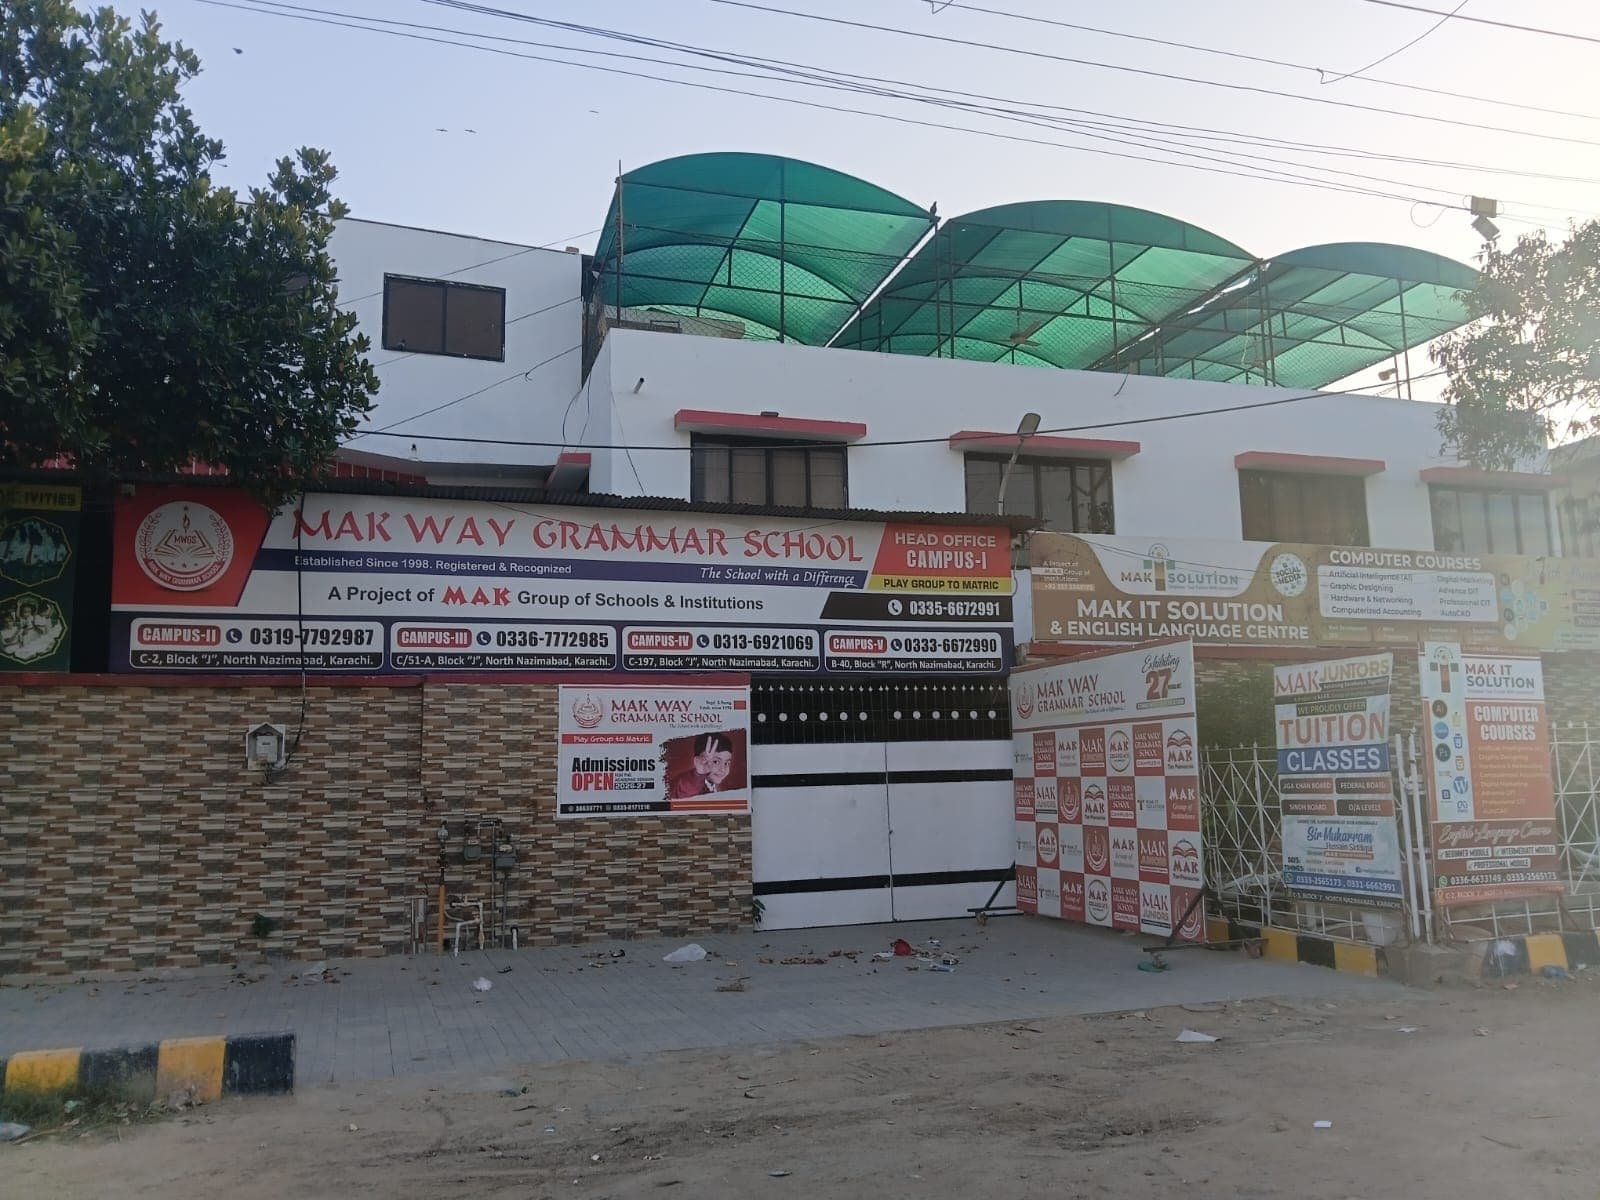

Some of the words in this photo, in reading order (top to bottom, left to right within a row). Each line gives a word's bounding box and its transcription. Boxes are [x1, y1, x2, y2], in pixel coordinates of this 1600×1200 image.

[292, 509, 392, 542] MAK
[403, 514, 516, 548] WAY
[532, 519, 729, 558] GRAMMAR
[743, 530, 863, 562] SCHOOL
[895, 531, 941, 547] HEAD
[942, 534, 998, 549] OFFICE
[295, 555, 363, 569] Established
[367, 557, 399, 569] Since
[402, 558, 433, 570] 1998.
[436, 559, 496, 574] Registered
[498, 561, 507, 572] &
[510, 562, 572, 576] Recognized
[907, 550, 988, 570] CAMPUS-I
[1329, 550, 1412, 568] COMPUTER
[1414, 554, 1482, 570] COURSES
[700, 567, 720, 579] The
[724, 568, 761, 581] School
[764, 570, 789, 582] with
[791, 574, 800, 582] a
[803, 572, 857, 587] Difference
[1120, 571, 1153, 583] MAK
[1168, 571, 1240, 586] SOLUTION
[1329, 570, 1359, 580] Artificial
[884, 579, 910, 589] PLAY
[911, 579, 946, 589] GROUP
[947, 580, 960, 590] TO
[962, 580, 999, 590] MATRIC
[1329, 582, 1358, 592] Graphic
[1358, 583, 1395, 594] Designing
[327, 585, 342, 601] A
[346, 586, 414, 606] Project
[416, 587, 437, 603] of
[441, 585, 513, 606] MAK
[516, 589, 570, 610] Group
[574, 591, 594, 606] of
[595, 592, 660, 609] Schools
[663, 594, 676, 608] &
[679, 595, 764, 611] Institutions
[1330, 593, 1366, 602] Hardware
[1373, 596, 1414, 606] Networking
[909, 600, 1001, 617] 0335-6672991
[1076, 598, 1133, 620] MAK
[1140, 600, 1161, 620] IT
[1167, 601, 1284, 623] SOLUTION
[1330, 605, 1382, 616] Computerized
[1382, 607, 1423, 618] Accounting
[1440, 609, 1472, 618] AutoCAD
[142, 627, 217, 643] CAMPUS-II
[249, 628, 375, 647] 0319-7792987
[1050, 620, 1063, 635] &
[1067, 621, 1143, 637] ENGLISH
[1148, 622, 1242, 639] LANGUAGE
[1246, 624, 1311, 640] CENTRE
[401, 631, 469, 645] CAMPUS-III
[495, 630, 610, 648] 0336-7772985
[631, 635, 690, 648] CAMPUS-IV
[712, 634, 815, 651] 0313-6921069
[833, 638, 885, 650] CAMPUS-V
[903, 638, 998, 653] 0333-6672990
[139, 653, 162, 667] C-2,
[166, 653, 199, 665] Block
[223, 654, 257, 666] North
[259, 654, 327, 668] Nazimabad,
[329, 654, 374, 666] Karachi.
[396, 655, 436, 668] C/51-A,
[437, 655, 466, 666] Block
[485, 656, 514, 667] North
[516, 656, 573, 669] Nazimabad,
[574, 657, 611, 668] Karachi.
[628, 657, 657, 669] C-197,
[659, 657, 684, 667] Block
[701, 658, 727, 668] North
[729, 658, 779, 669] Nazimabad,
[781, 658, 815, 669] Karachi.
[831, 659, 854, 670] B-40,
[854, 659, 876, 669] Block
[894, 660, 918, 670] North
[920, 660, 965, 672] Nazimabad,
[965, 661, 997, 671] Karachi.
[1274, 669, 1321, 694] MAK
[1319, 659, 1390, 682] JUNIORS
[1464, 662, 1496, 675] MAK
[1499, 664, 1513, 676] IT
[1036, 678, 1065, 699] MAK
[1068, 672, 1101, 693] WAY
[1144, 667, 1175, 701] 27
[1466, 675, 1536, 689] SOLUTION
[610, 699, 649, 712] MAK
[654, 699, 693, 712] WAY
[1036, 695, 1085, 713] GRAMMAR
[1088, 690, 1127, 708] SCHOOL
[1310, 703, 1343, 714] PROUDLY
[610, 712, 676, 724] GRAMMAR
[679, 713, 724, 724] SCHOOL
[1473, 705, 1539, 723] COMPUTER
[1278, 712, 1386, 745] TUITION
[1480, 724, 1537, 741] COURSES
[573, 735, 589, 744] Play
[590, 735, 615, 744] Group
[1058, 742, 1078, 753] MAK
[1080, 737, 1106, 753] MAK
[1109, 741, 1130, 752] MAK
[571, 756, 657, 773] Admissions
[1167, 750, 1193, 763] MAK
[1286, 747, 1381, 772] CLASSES
[571, 772, 614, 791] OPEN
[1340, 781, 1366, 790] FEDERAL
[1036, 785, 1057, 801] MAK
[1169, 788, 1196, 801] MAK
[1084, 802, 1105, 814] MAK
[1307, 825, 1322, 842] Sir
[1323, 825, 1373, 844] Mukarram
[1438, 824, 1475, 846] English
[1112, 837, 1135, 850] MAK
[1140, 840, 1168, 857] MAK
[1172, 860, 1199, 874] MAK
[1017, 873, 1037, 890] MAK
[1062, 879, 1083, 893] MAK
[1088, 889, 1109, 902] MAK
[1142, 893, 1169, 911] MAK
